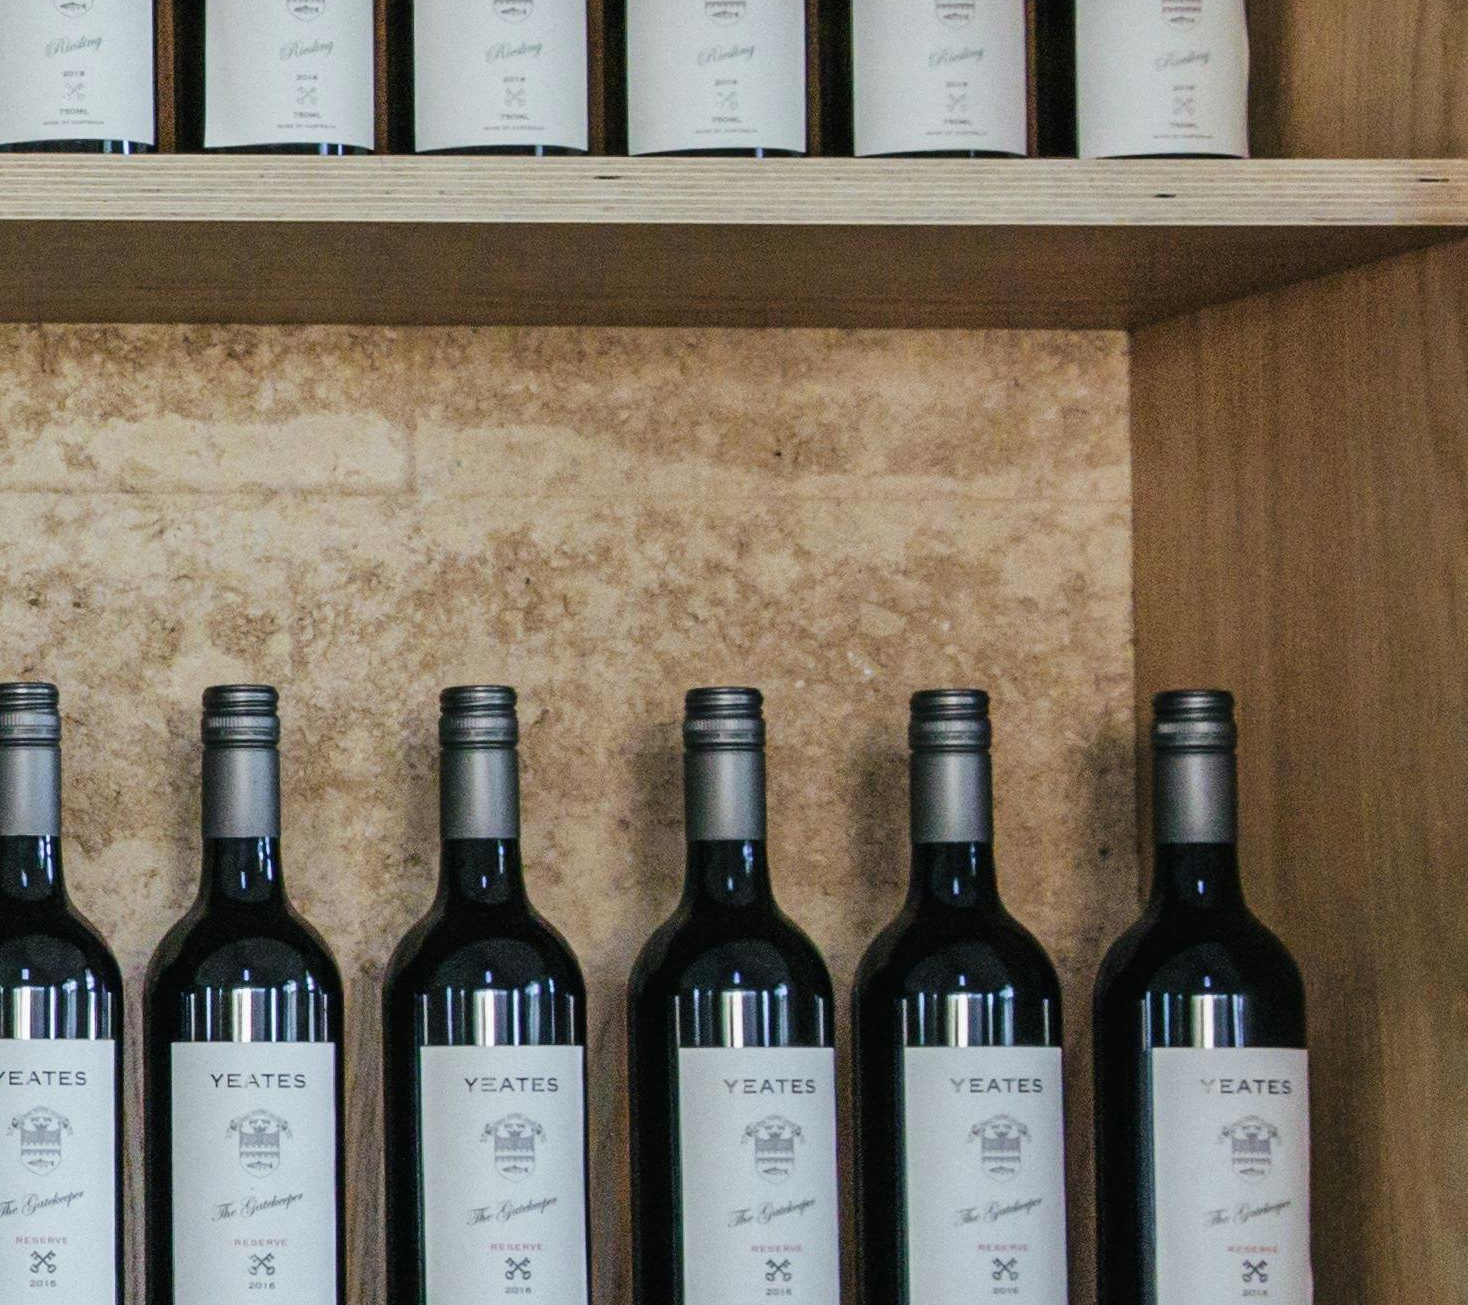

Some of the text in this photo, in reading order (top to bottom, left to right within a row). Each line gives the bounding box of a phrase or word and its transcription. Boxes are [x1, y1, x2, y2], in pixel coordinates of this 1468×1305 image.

[46, 36, 102, 57] Riesling
[279, 40, 334, 61] Riesling
[211, 1073, 306, 1089] YEATES
[465, 1077, 559, 1093] YEATES
[724, 1079, 816, 1094] YEATES
[950, 1078, 1043, 1093] YEATES
[1200, 1079, 1292, 1095] YEATES
[22, 1191, 85, 1217] Gatekeeper
[213, 1193, 304, 1222] The Gatekeeper
[467, 1197, 557, 1227] The Gatekeeper
[728, 1208, 754, 1228] The
[491, 1243, 544, 1251] RESERVE
[752, 1245, 802, 1253] RESERVE
[29, 1280, 57, 1288] 2016
[248, 1282, 276, 1290] 2016
[504, 1286, 532, 1295] 2016
[766, 1288, 792, 1297] 2016
